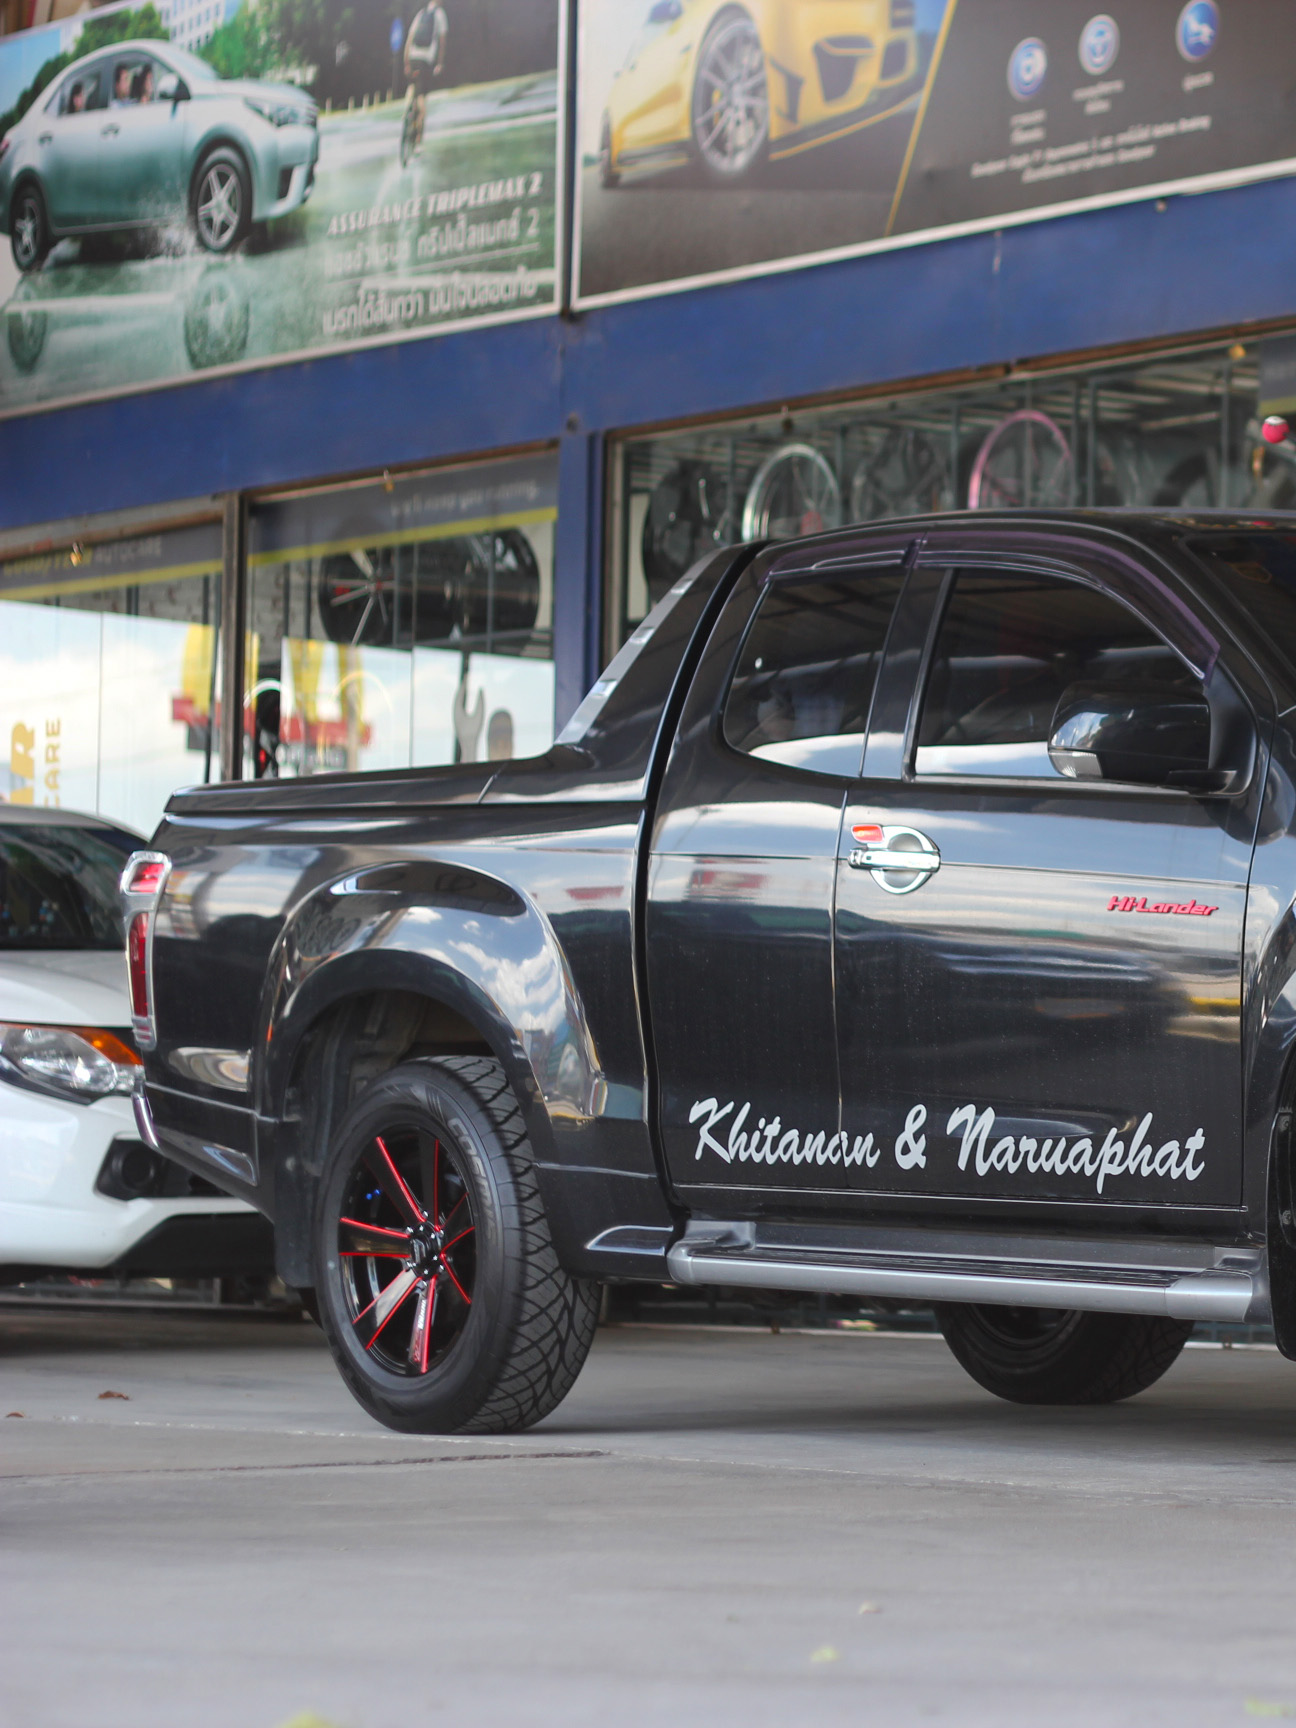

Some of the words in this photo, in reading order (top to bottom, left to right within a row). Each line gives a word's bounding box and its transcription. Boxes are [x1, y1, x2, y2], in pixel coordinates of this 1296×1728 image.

[688, 1097, 881, 1166] Khitanan
[895, 1104, 927, 1169] &
[946, 1104, 1206, 1194] Naruaphat
